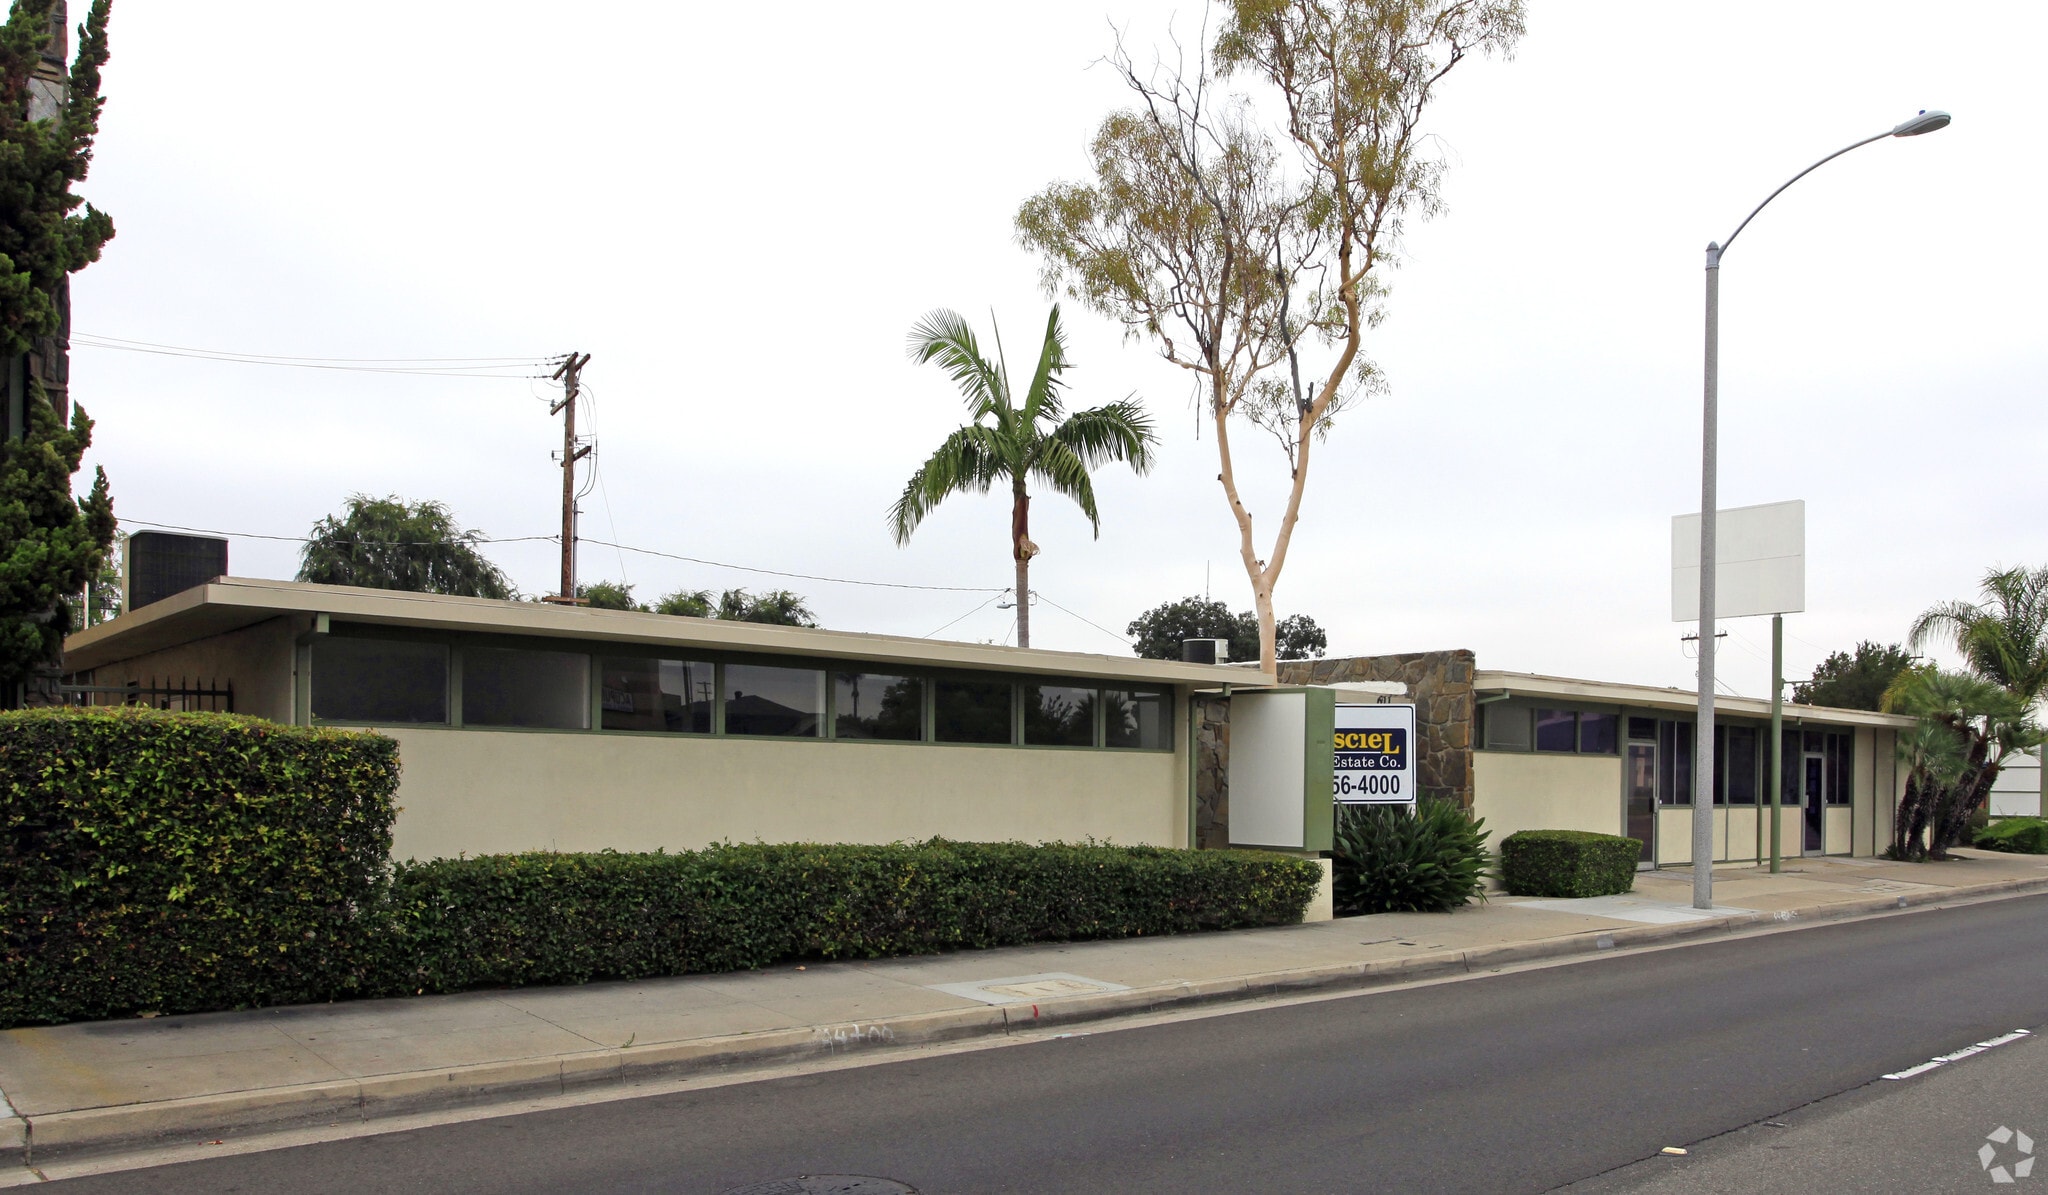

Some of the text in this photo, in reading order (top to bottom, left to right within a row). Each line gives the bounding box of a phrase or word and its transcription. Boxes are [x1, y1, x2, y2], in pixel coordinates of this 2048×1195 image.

[1333, 756, 1401, 768] Estate Co.
[1333, 775, 1399, 794] 56-4000
